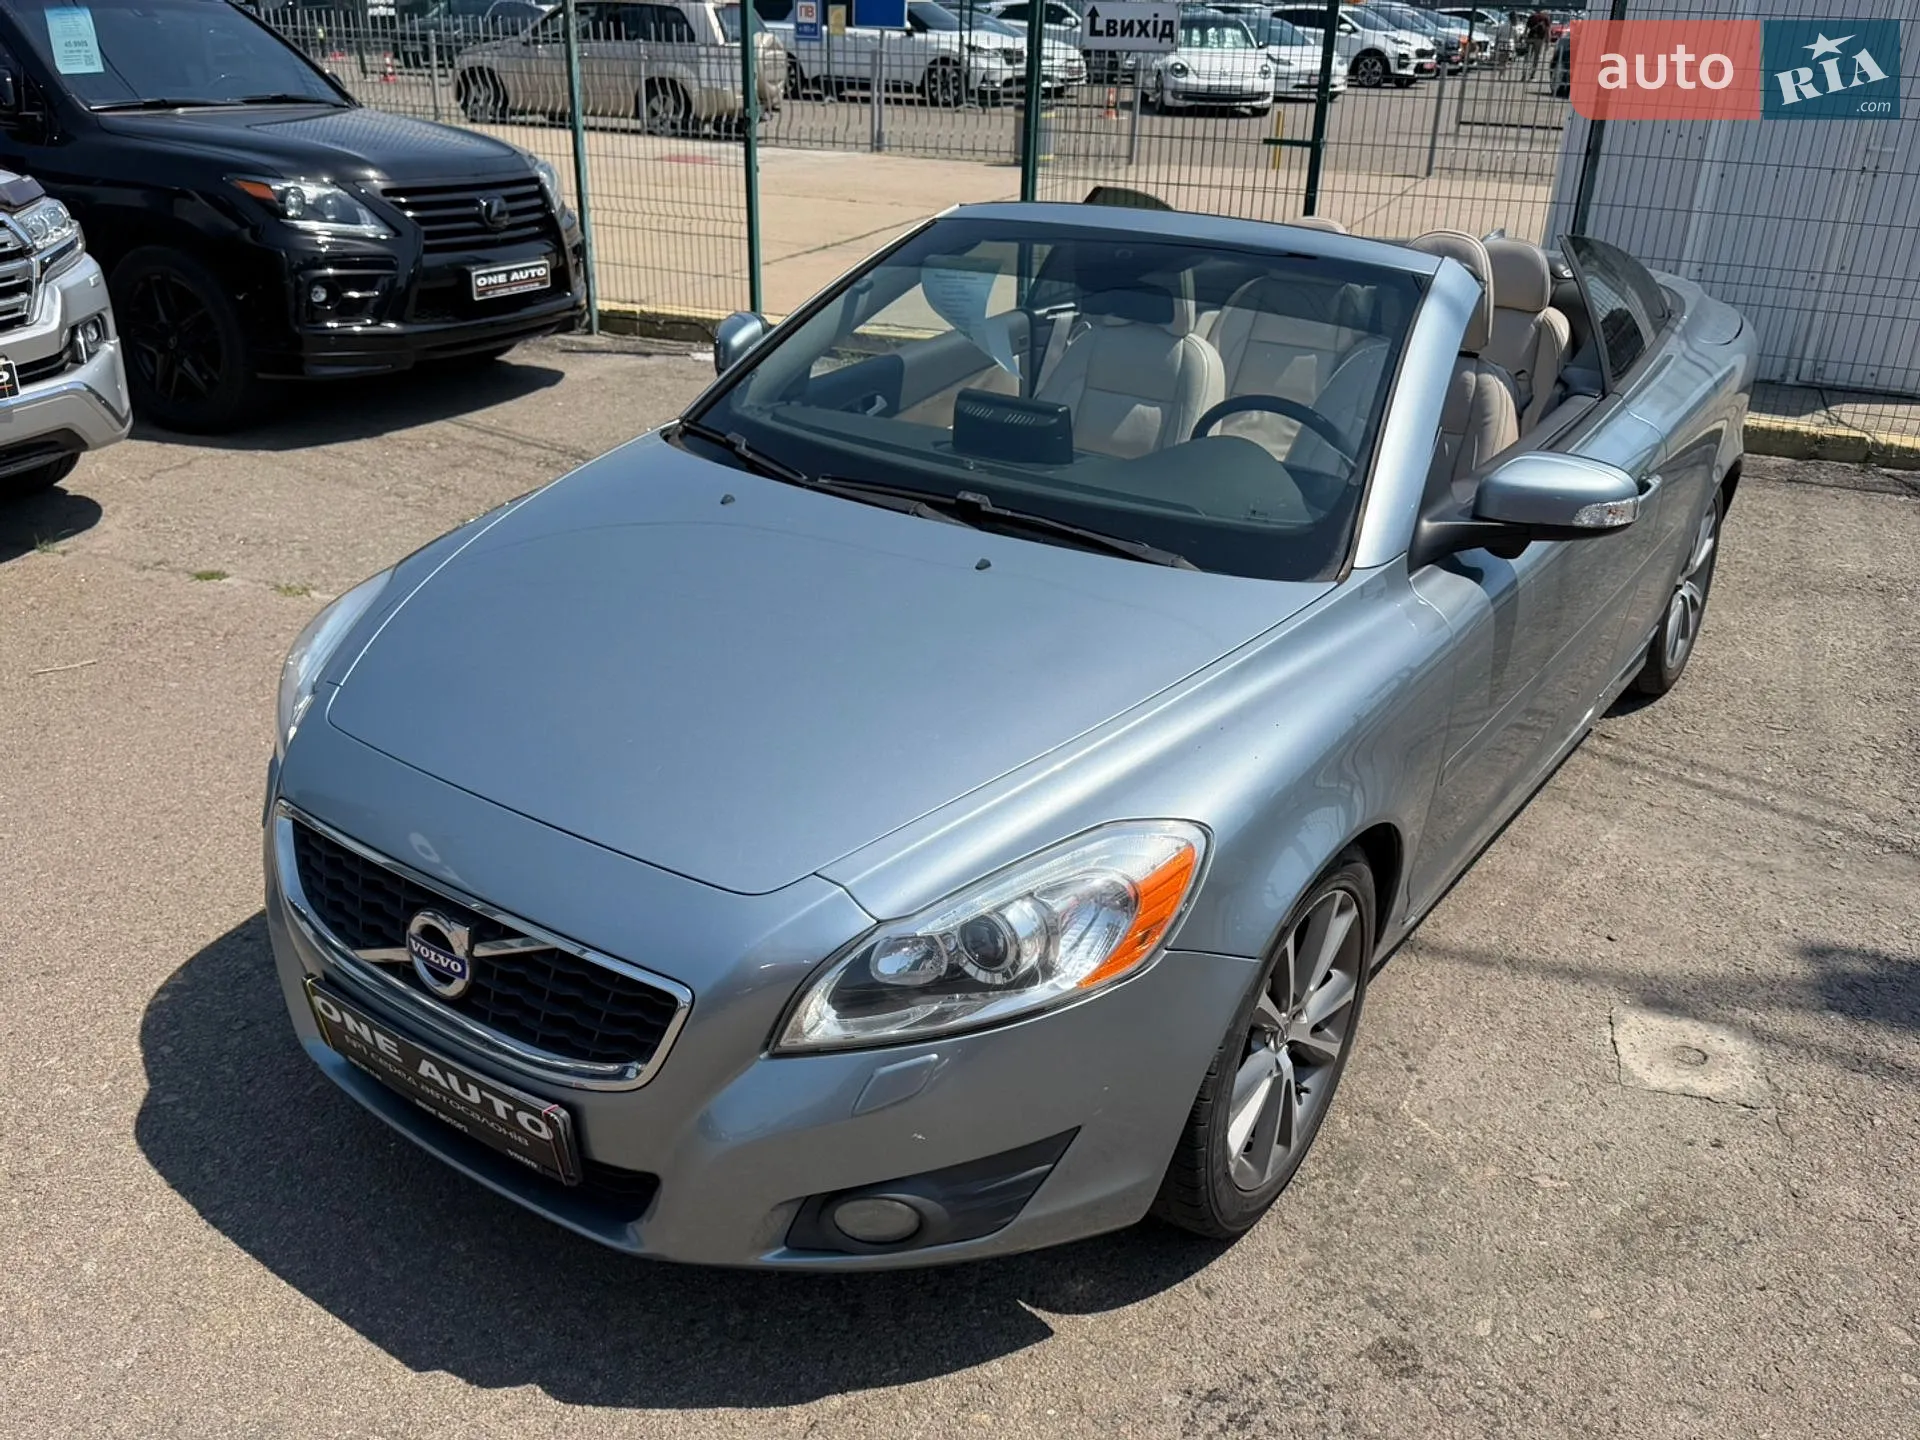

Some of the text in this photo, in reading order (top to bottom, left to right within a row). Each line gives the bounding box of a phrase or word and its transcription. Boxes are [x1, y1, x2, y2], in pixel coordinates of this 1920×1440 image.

[1105, 13, 1175, 44] вихід
[476, 266, 547, 287] ONE AUTO
[410, 937, 462, 973] VOLVO
[312, 995, 404, 1063] ONE
[417, 1059, 554, 1140] AUTO
